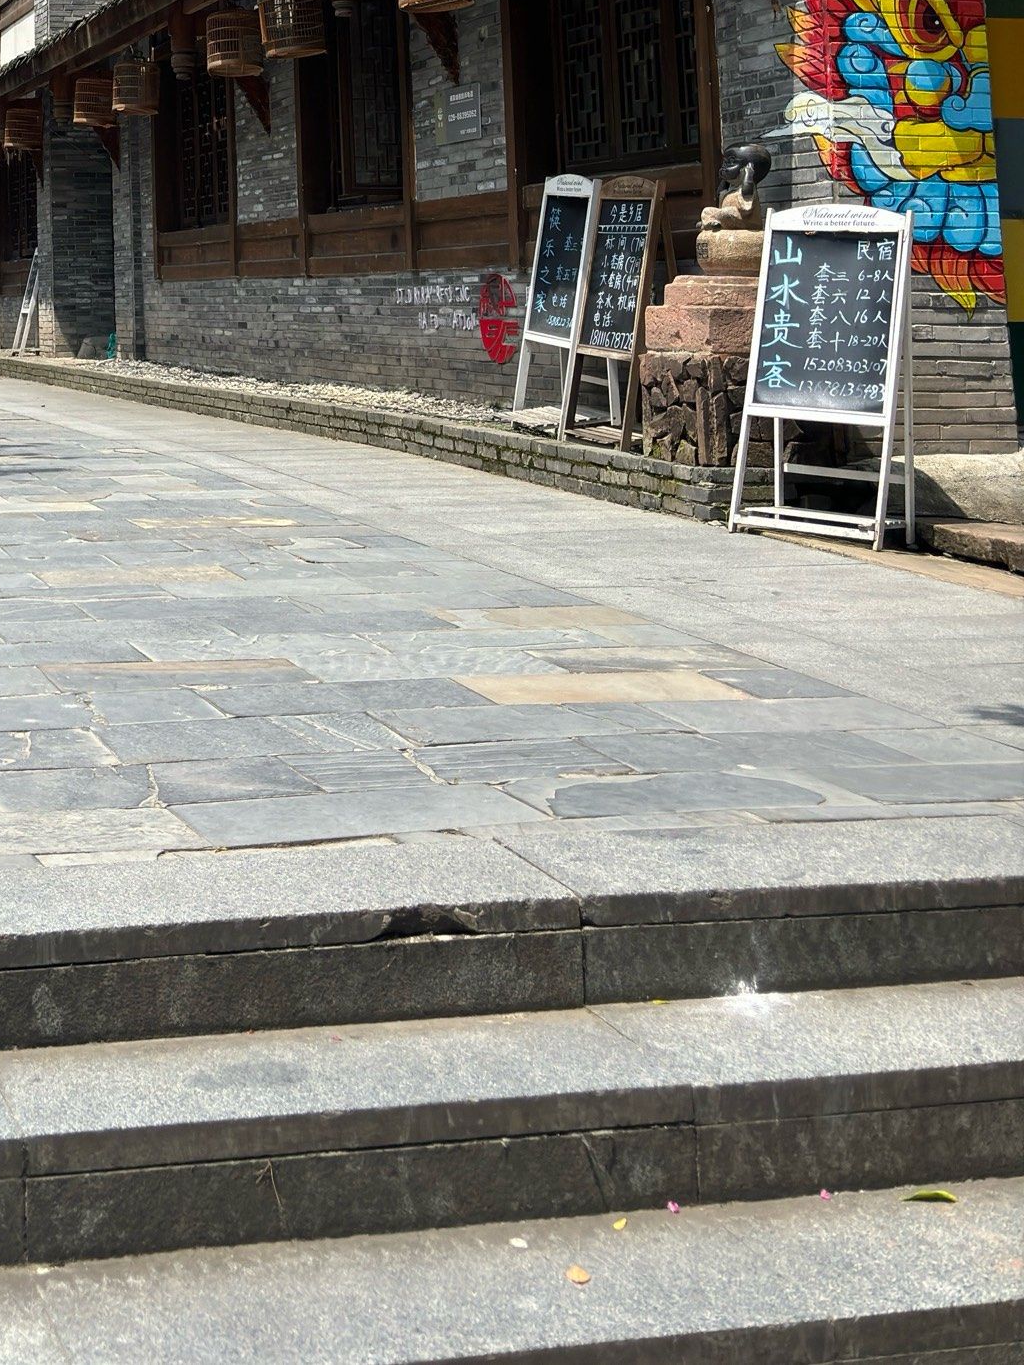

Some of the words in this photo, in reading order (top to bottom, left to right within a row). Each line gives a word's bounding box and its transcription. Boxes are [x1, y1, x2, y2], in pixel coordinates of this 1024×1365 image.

[802, 207, 849, 219] Natural
[850, 210, 880, 219] wind
[857, 239, 895, 261] 民宿
[803, 357, 888, 375] 15208303107
